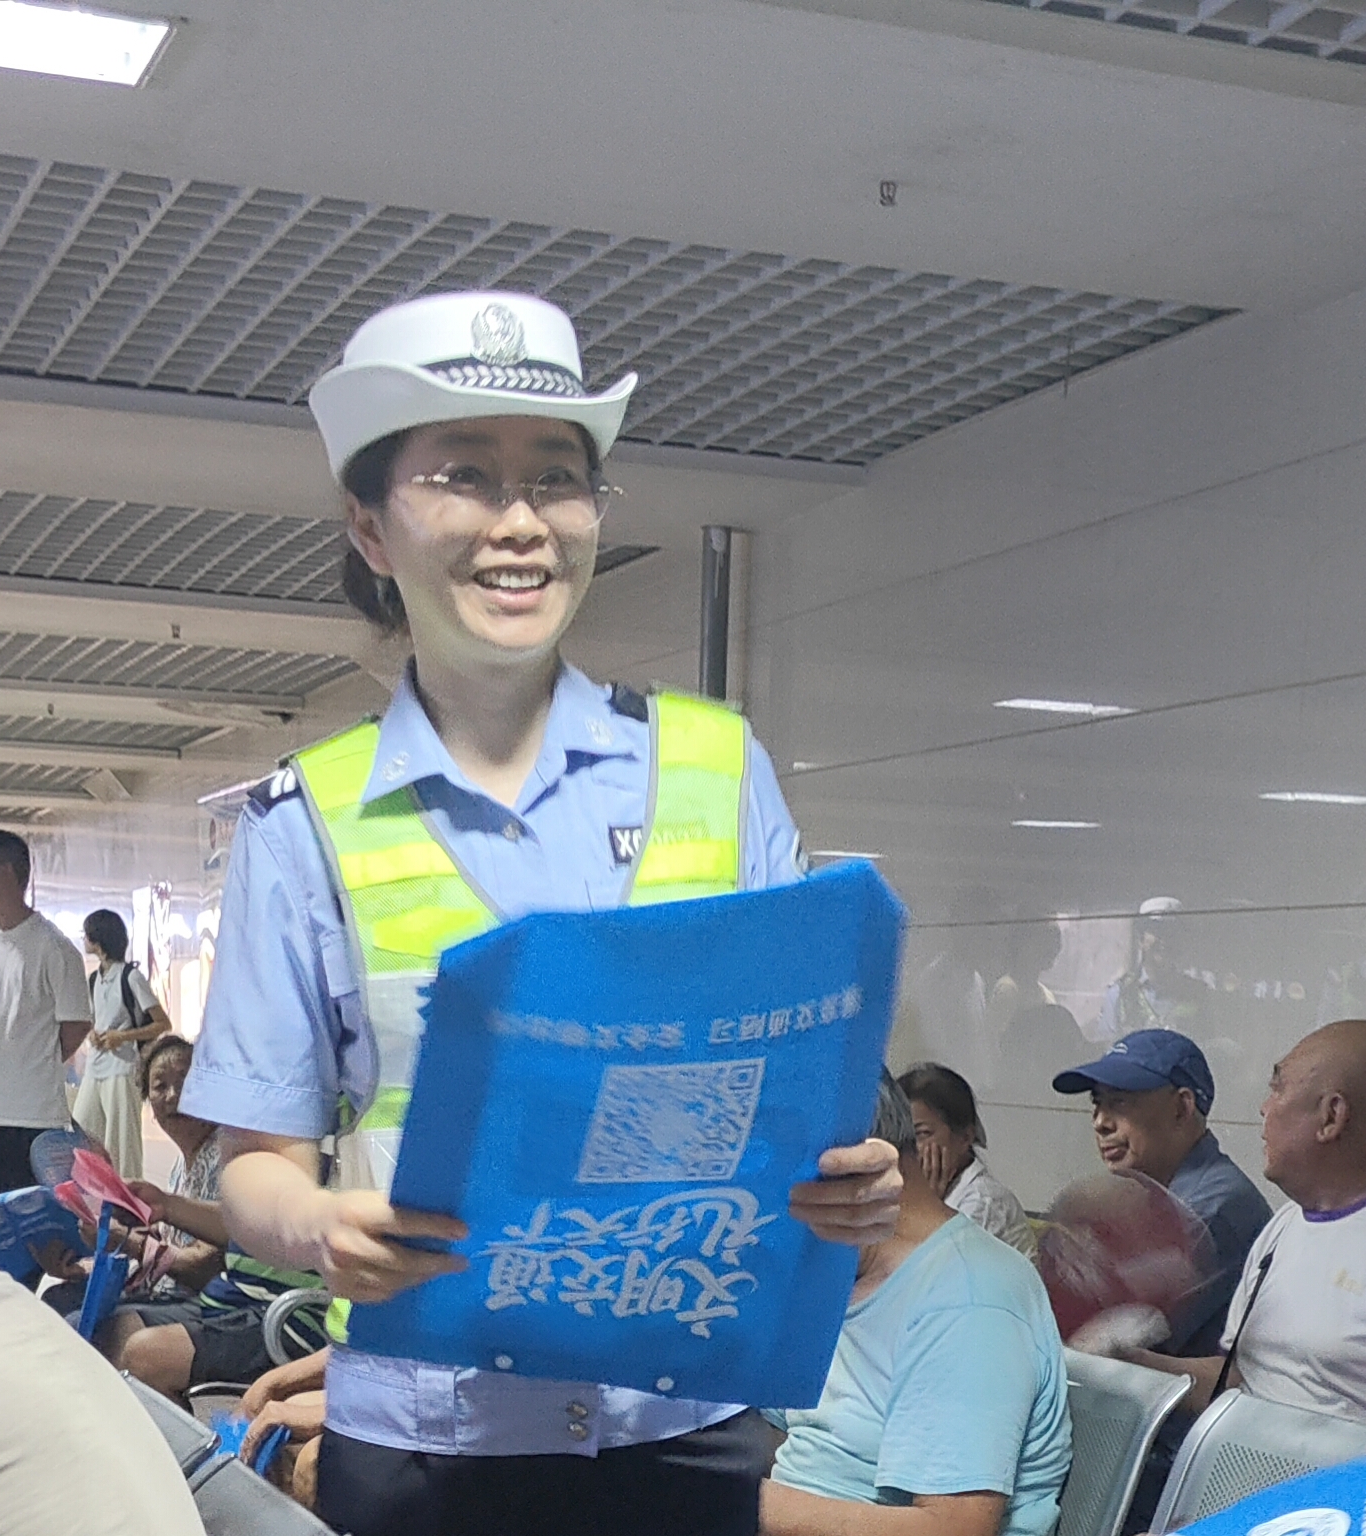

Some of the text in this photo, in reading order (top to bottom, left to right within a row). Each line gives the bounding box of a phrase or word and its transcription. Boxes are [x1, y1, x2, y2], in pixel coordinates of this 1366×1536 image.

[483, 1187, 778, 1265] 礼行天下
[473, 1246, 759, 1338] 文明交通
